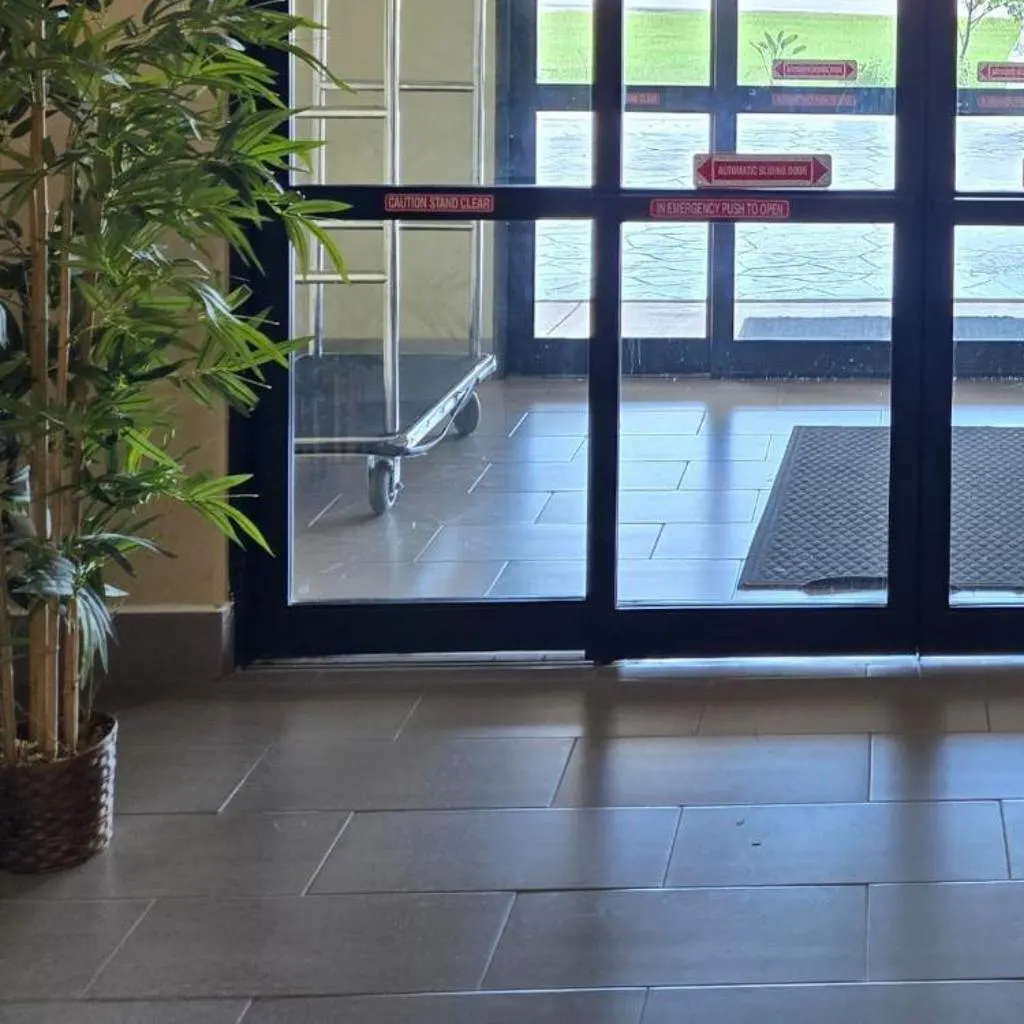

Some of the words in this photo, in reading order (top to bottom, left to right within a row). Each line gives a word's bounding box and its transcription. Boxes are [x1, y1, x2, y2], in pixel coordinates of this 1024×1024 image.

[718, 165, 758, 176] AUTOMATIC
[388, 196, 427, 209] CAUTION
[429, 197, 458, 209] STAND
[460, 197, 490, 209] CLEAR
[656, 202, 665, 215] IN
[667, 202, 720, 215] EMERGENCY
[722, 202, 745, 215] PUSH
[747, 202, 758, 215] TO
[761, 203, 783, 216] OPEN
